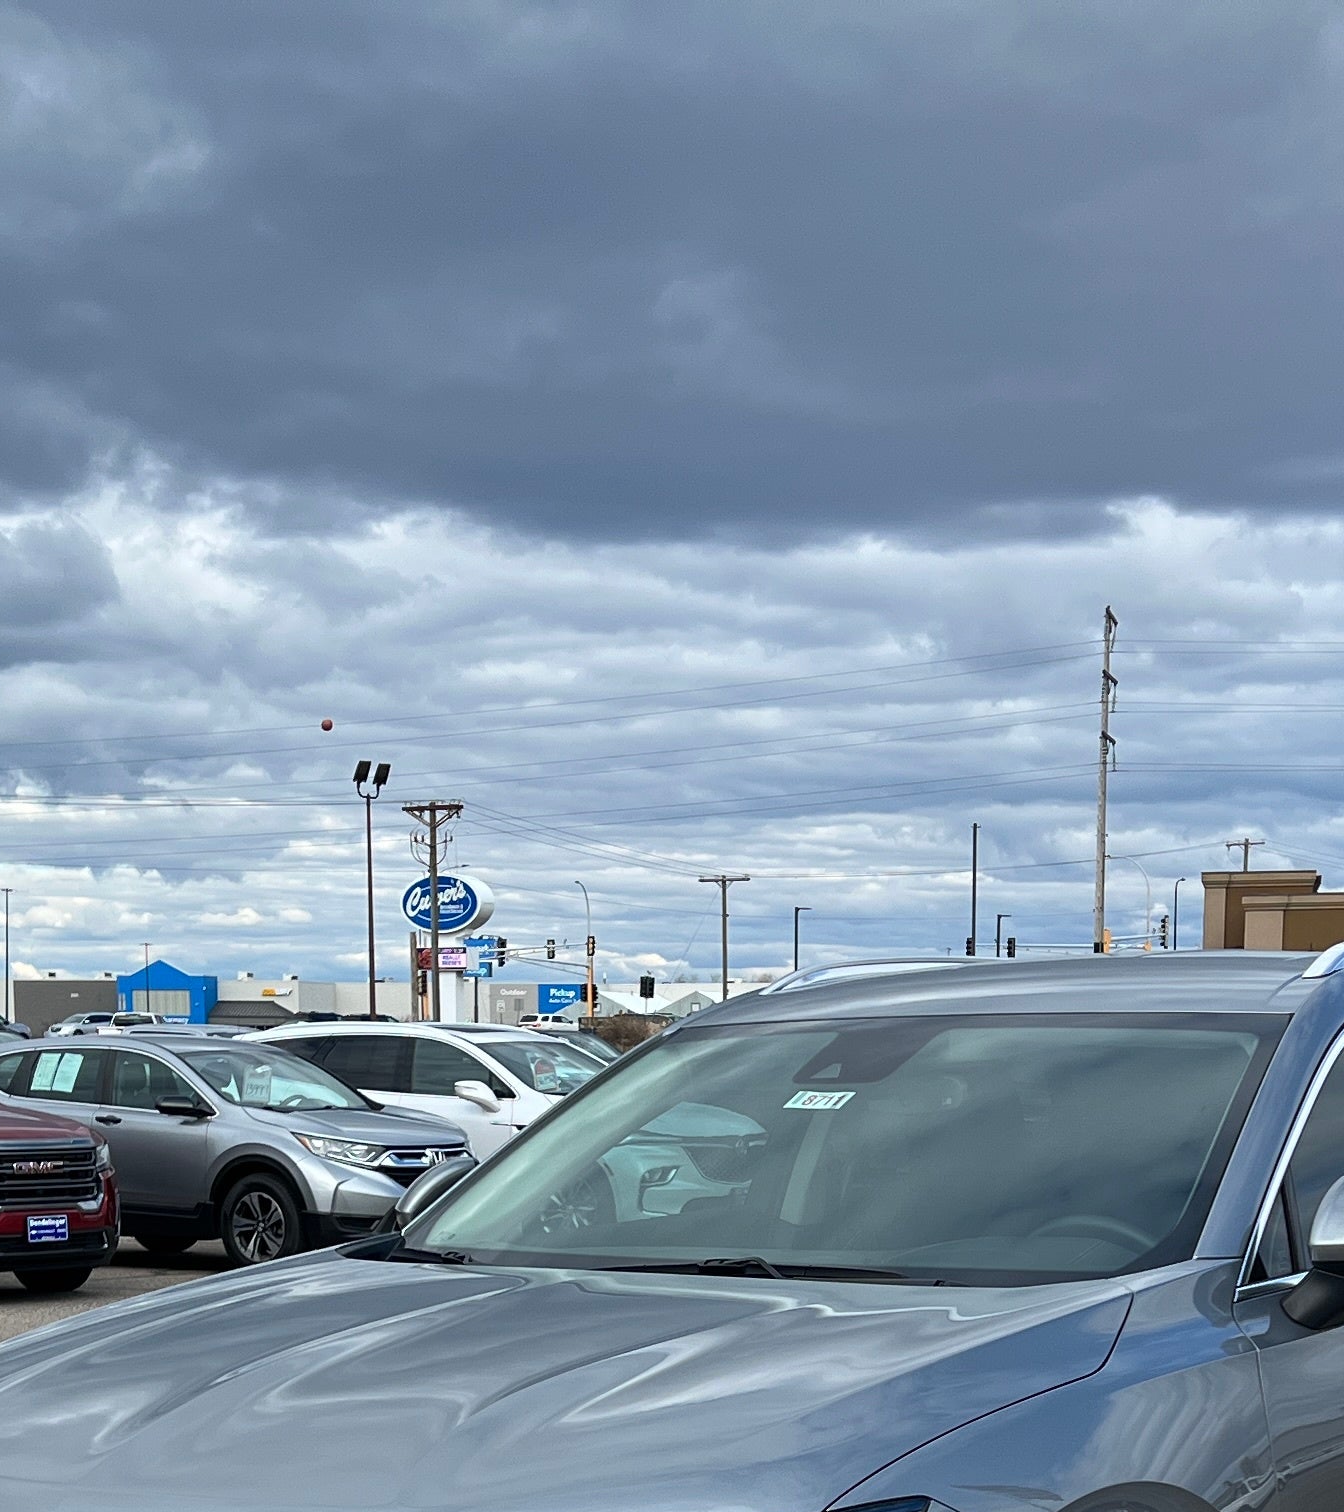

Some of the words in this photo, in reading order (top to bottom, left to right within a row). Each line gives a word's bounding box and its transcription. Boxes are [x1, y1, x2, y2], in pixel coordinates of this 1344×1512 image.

[406, 880, 467, 917] Cuver's
[500, 988, 528, 996] Outdoor
[549, 988, 576, 999] Pickup
[13, 1161, 64, 1174] GMC
